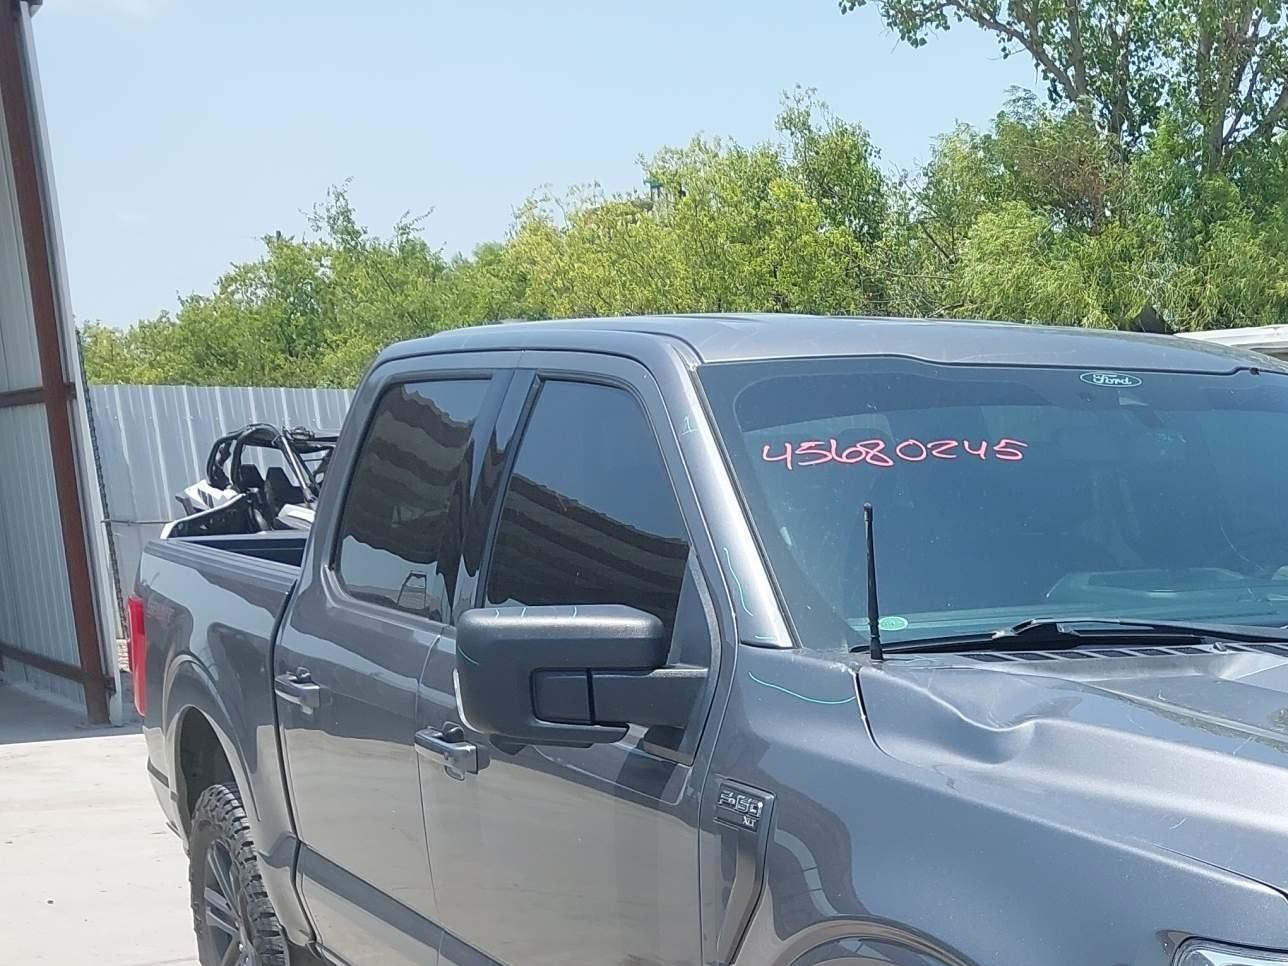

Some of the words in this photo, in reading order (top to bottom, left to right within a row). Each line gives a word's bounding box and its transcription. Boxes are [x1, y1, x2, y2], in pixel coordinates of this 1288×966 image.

[1092, 373, 1133, 385] Ford
[761, 438, 1029, 470] 45680245
[743, 815, 756, 827] XLT
